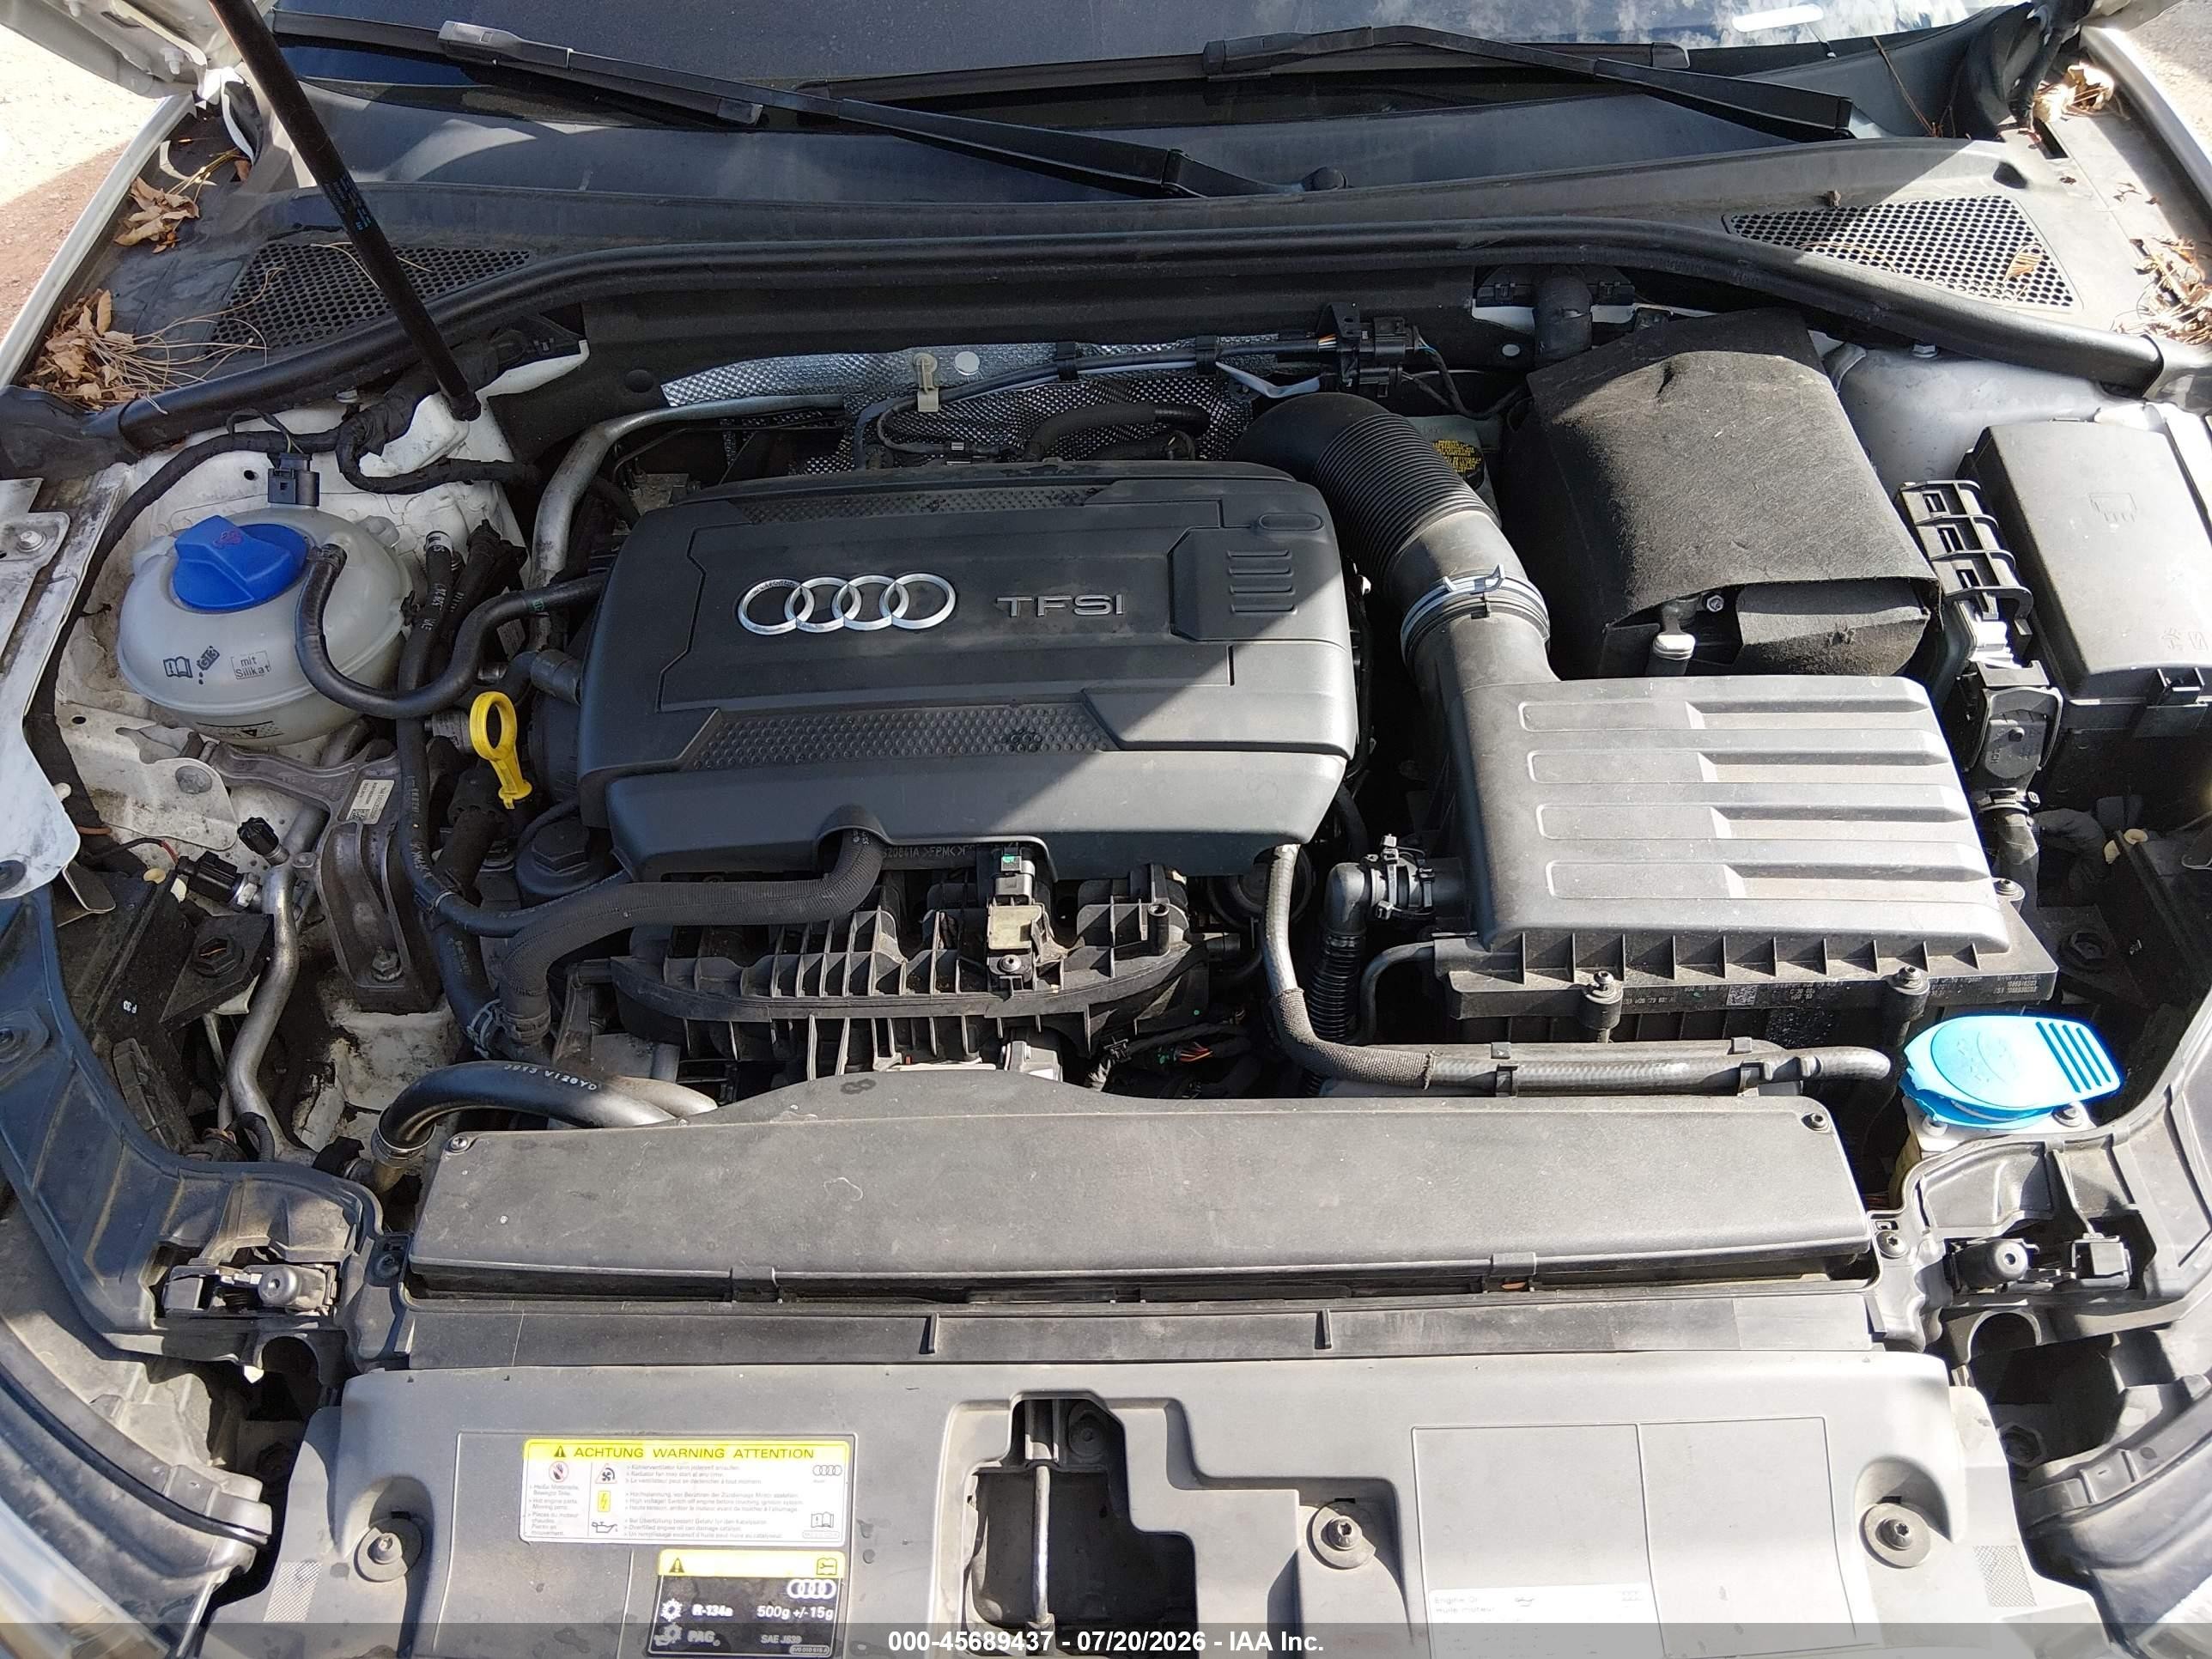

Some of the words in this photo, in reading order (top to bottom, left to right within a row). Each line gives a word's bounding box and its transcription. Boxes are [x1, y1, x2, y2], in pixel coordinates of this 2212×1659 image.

[996, 593, 1124, 618] TFSI
[574, 1448, 644, 1459] ACHTUNG
[653, 1448, 726, 1459] WARNING
[733, 1449, 814, 1460] ATTENTION
[691, 1603, 734, 1618] R-134a
[757, 1605, 791, 1620] 500g
[760, 1634, 780, 1644] SAE
